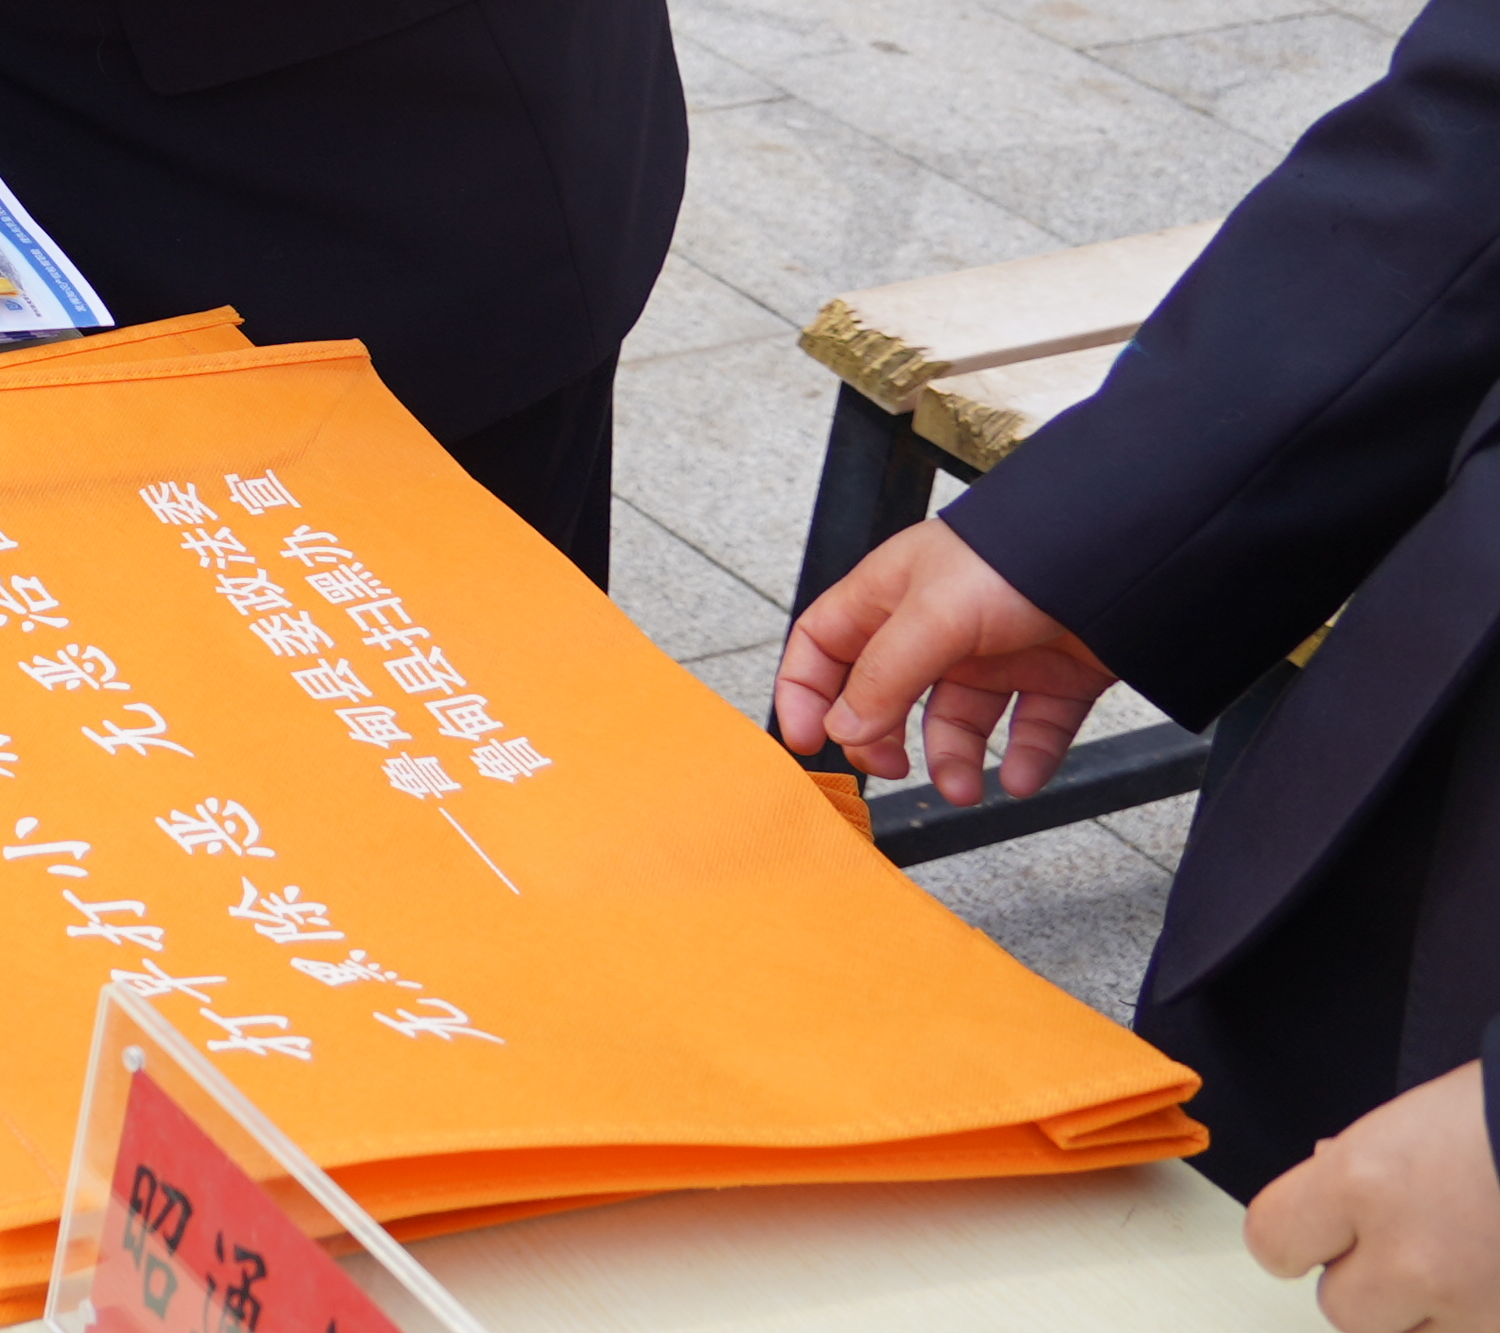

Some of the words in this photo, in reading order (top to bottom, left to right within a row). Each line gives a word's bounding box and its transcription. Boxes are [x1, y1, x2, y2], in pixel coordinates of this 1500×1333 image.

[223, 468, 302, 515] 宣
[279, 523, 552, 783] 鲁甸县扫黑办
[2, 815, 312, 1060] 打早打小
[155, 797, 505, 1044] 无黑除恶
[122, 1164, 338, 1333] 昭通
